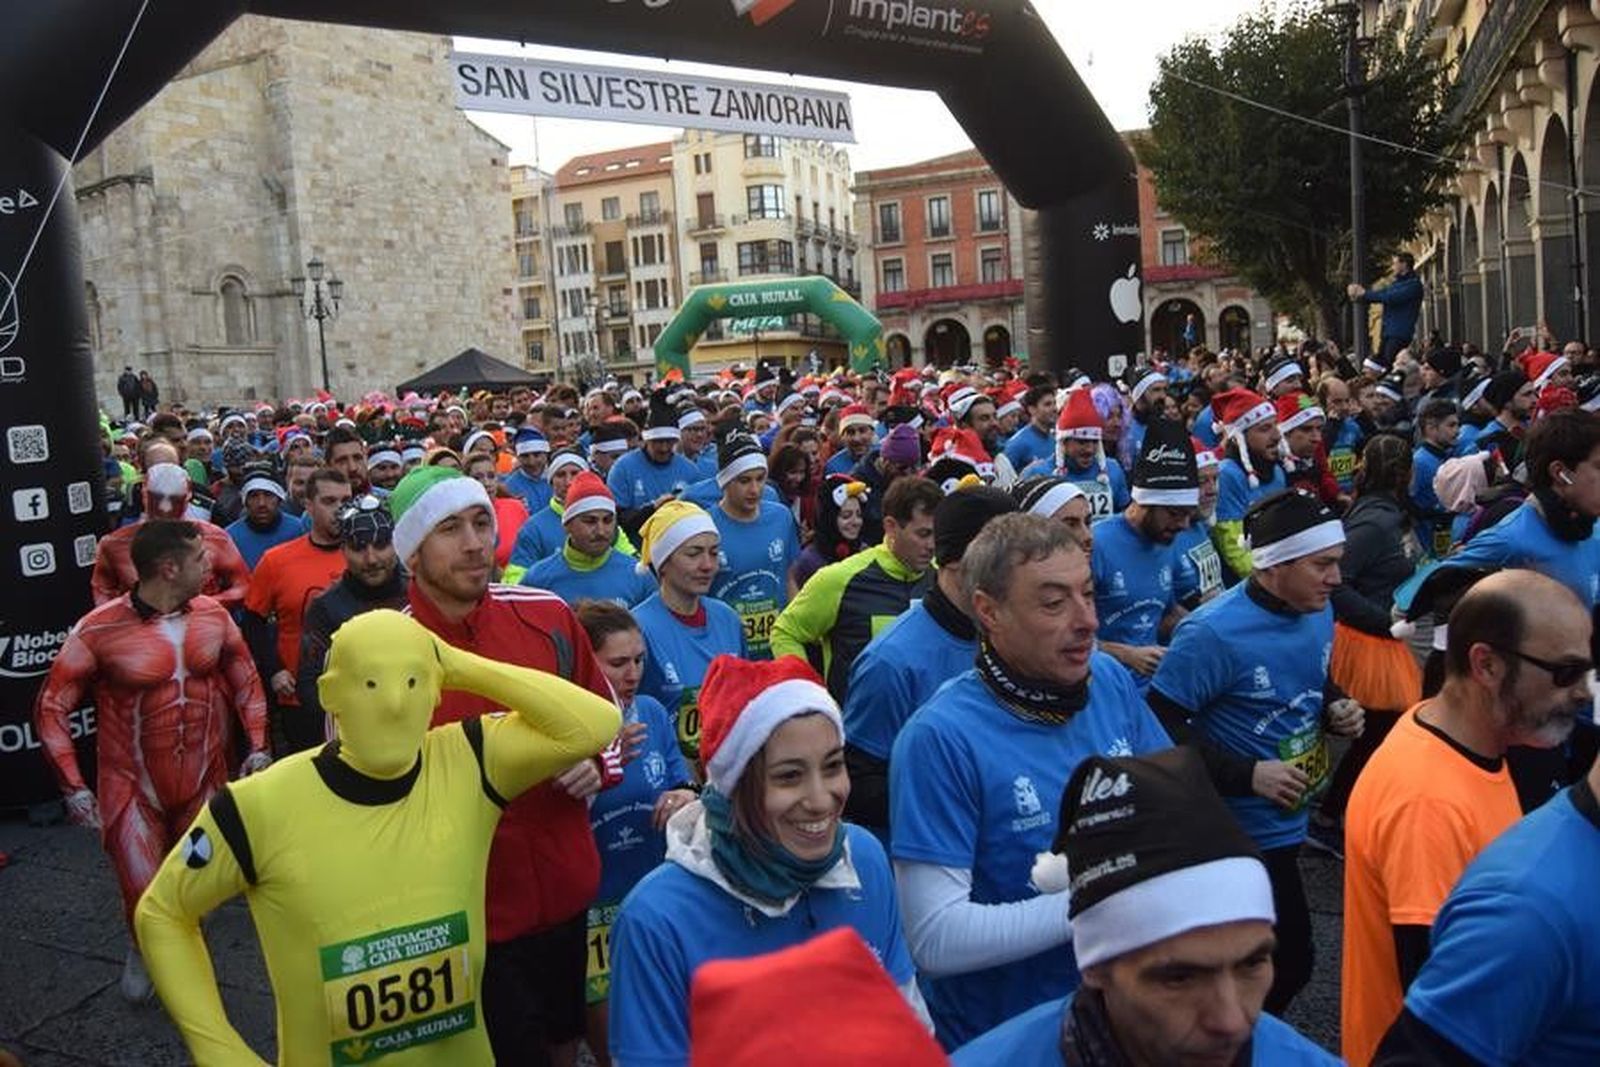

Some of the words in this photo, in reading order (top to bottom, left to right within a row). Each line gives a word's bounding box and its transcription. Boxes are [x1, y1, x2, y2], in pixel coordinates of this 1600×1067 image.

[457, 63, 531, 101] SAN
[539, 70, 701, 116] SILVESTRE
[705, 86, 852, 131] ZAMORANA
[761, 289, 804, 304] RURAL
[732, 315, 784, 332] META
[367, 922, 451, 954] FUNDACION
[369, 947, 403, 966] CAJA
[405, 936, 450, 957] RURAL
[346, 957, 454, 1032] 0581
[374, 1029, 413, 1049] CAJA
[416, 1013, 468, 1038] RURAL
